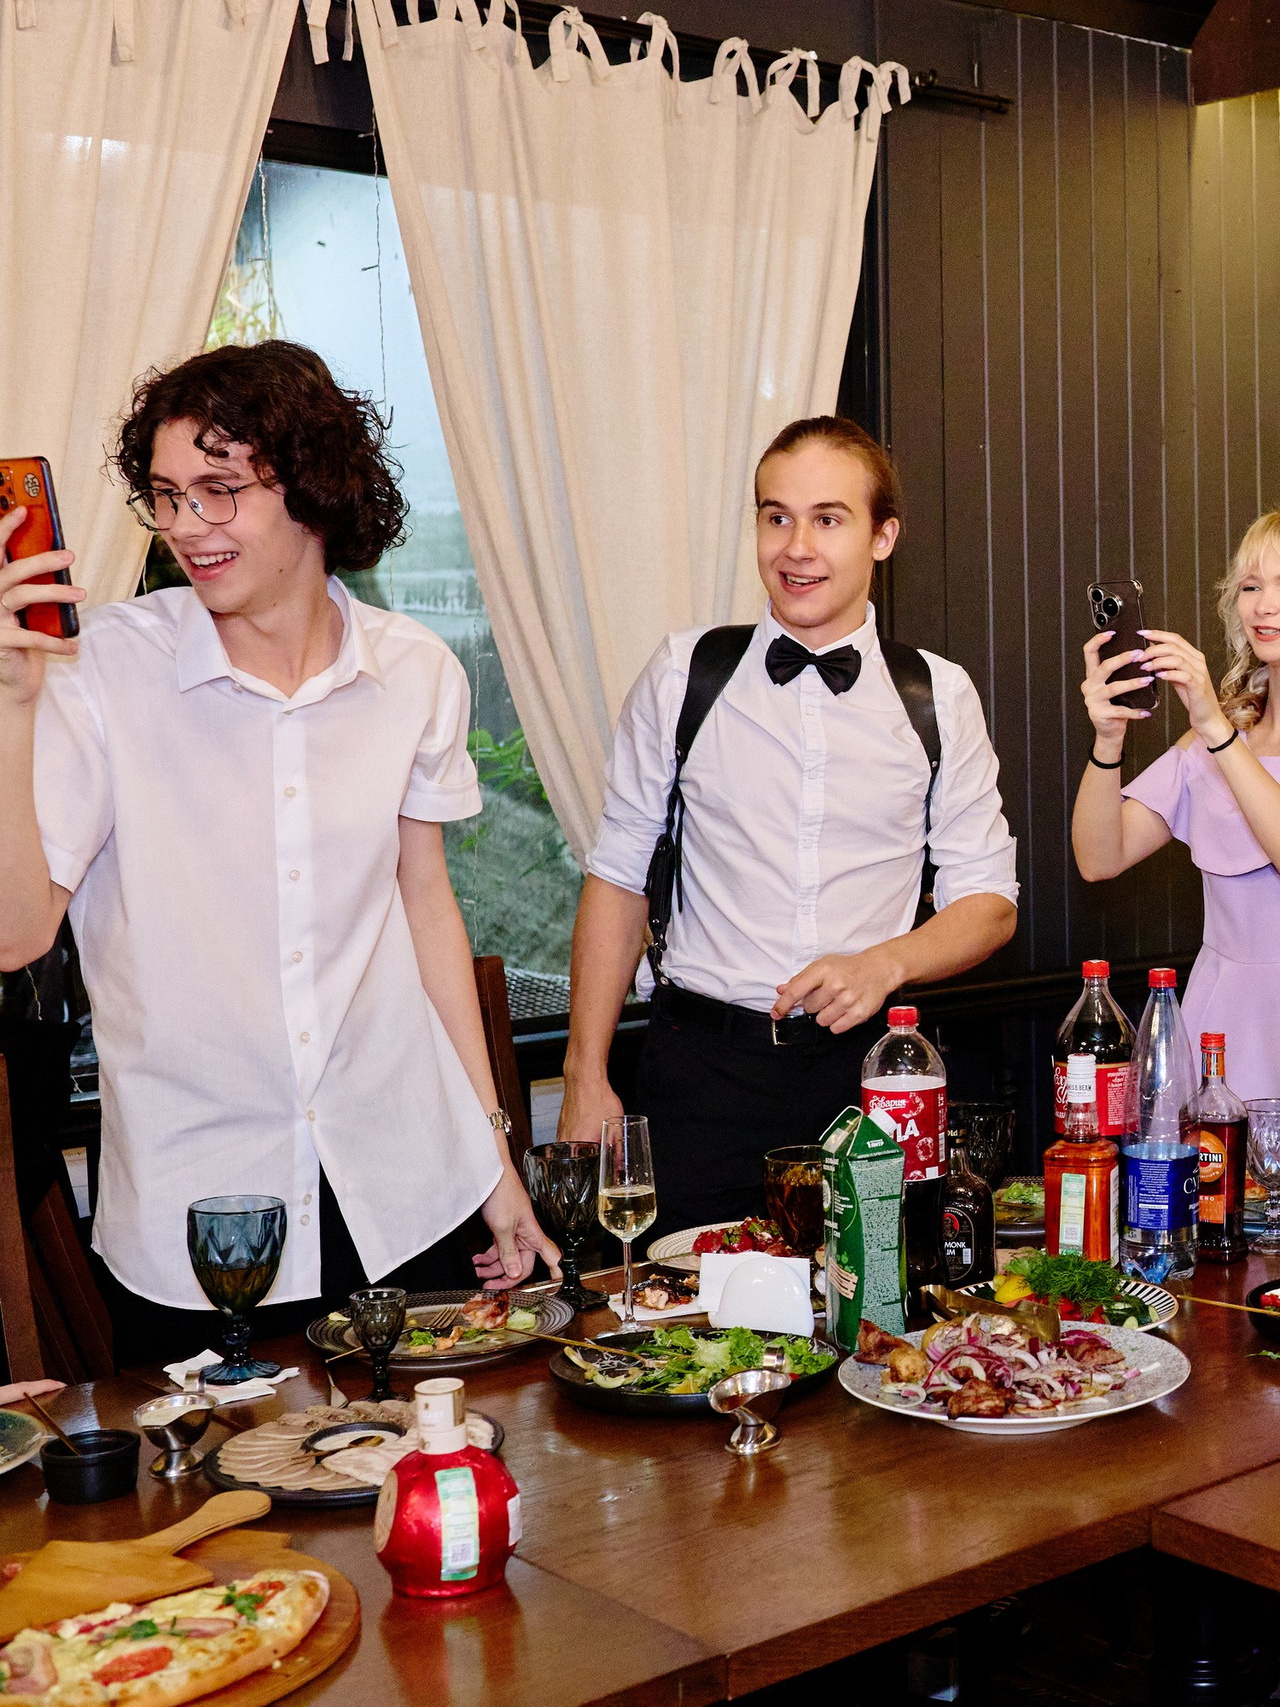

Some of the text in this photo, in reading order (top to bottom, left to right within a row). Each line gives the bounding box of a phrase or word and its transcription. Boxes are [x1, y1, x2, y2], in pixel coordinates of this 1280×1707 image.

[890, 1119, 920, 1143] ЛА
[1199, 1153, 1223, 1163] RTINI
[944, 1241, 967, 1249] MONK
